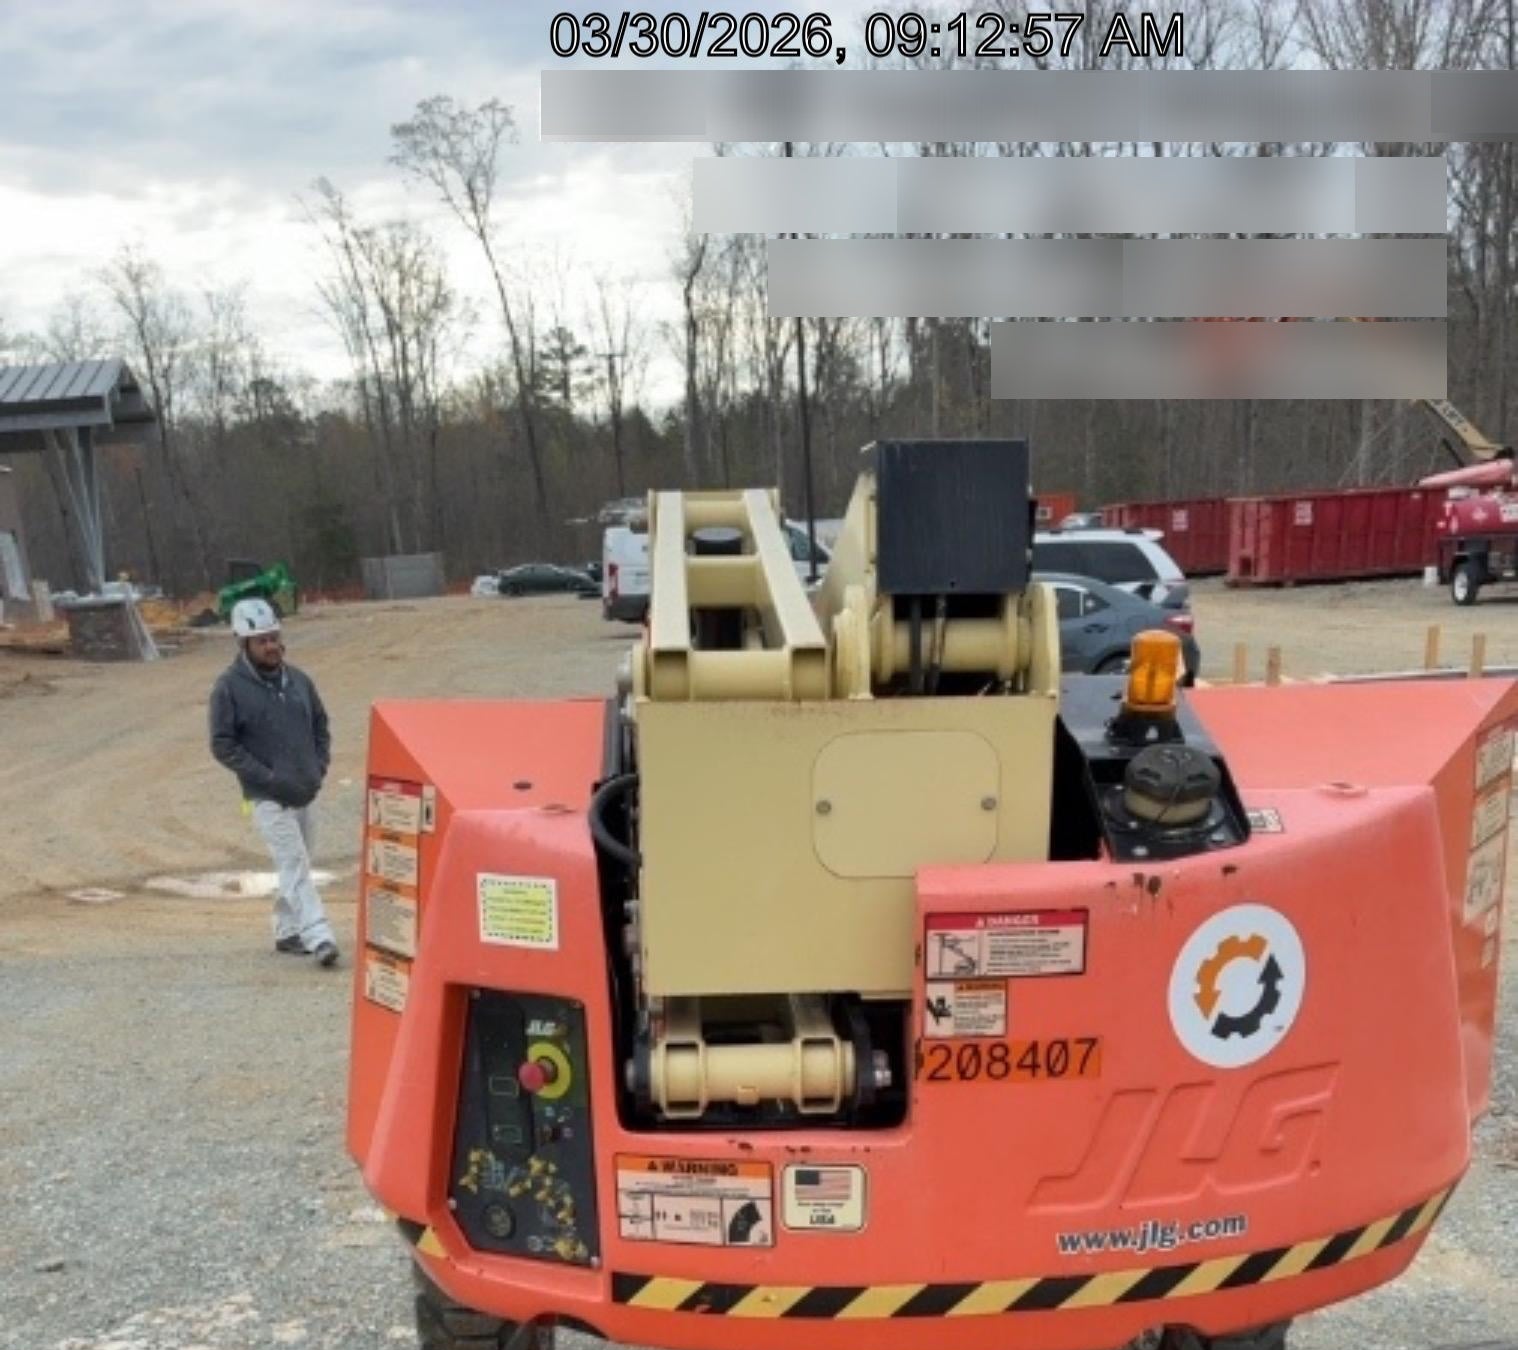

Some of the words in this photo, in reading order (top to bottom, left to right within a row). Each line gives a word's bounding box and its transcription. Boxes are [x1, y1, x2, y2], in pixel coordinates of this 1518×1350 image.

[926, 1037, 1099, 1081] 208407
[1026, 1060, 1341, 1213] JLG
[1057, 1213, 1248, 1253] www.jlg.com
